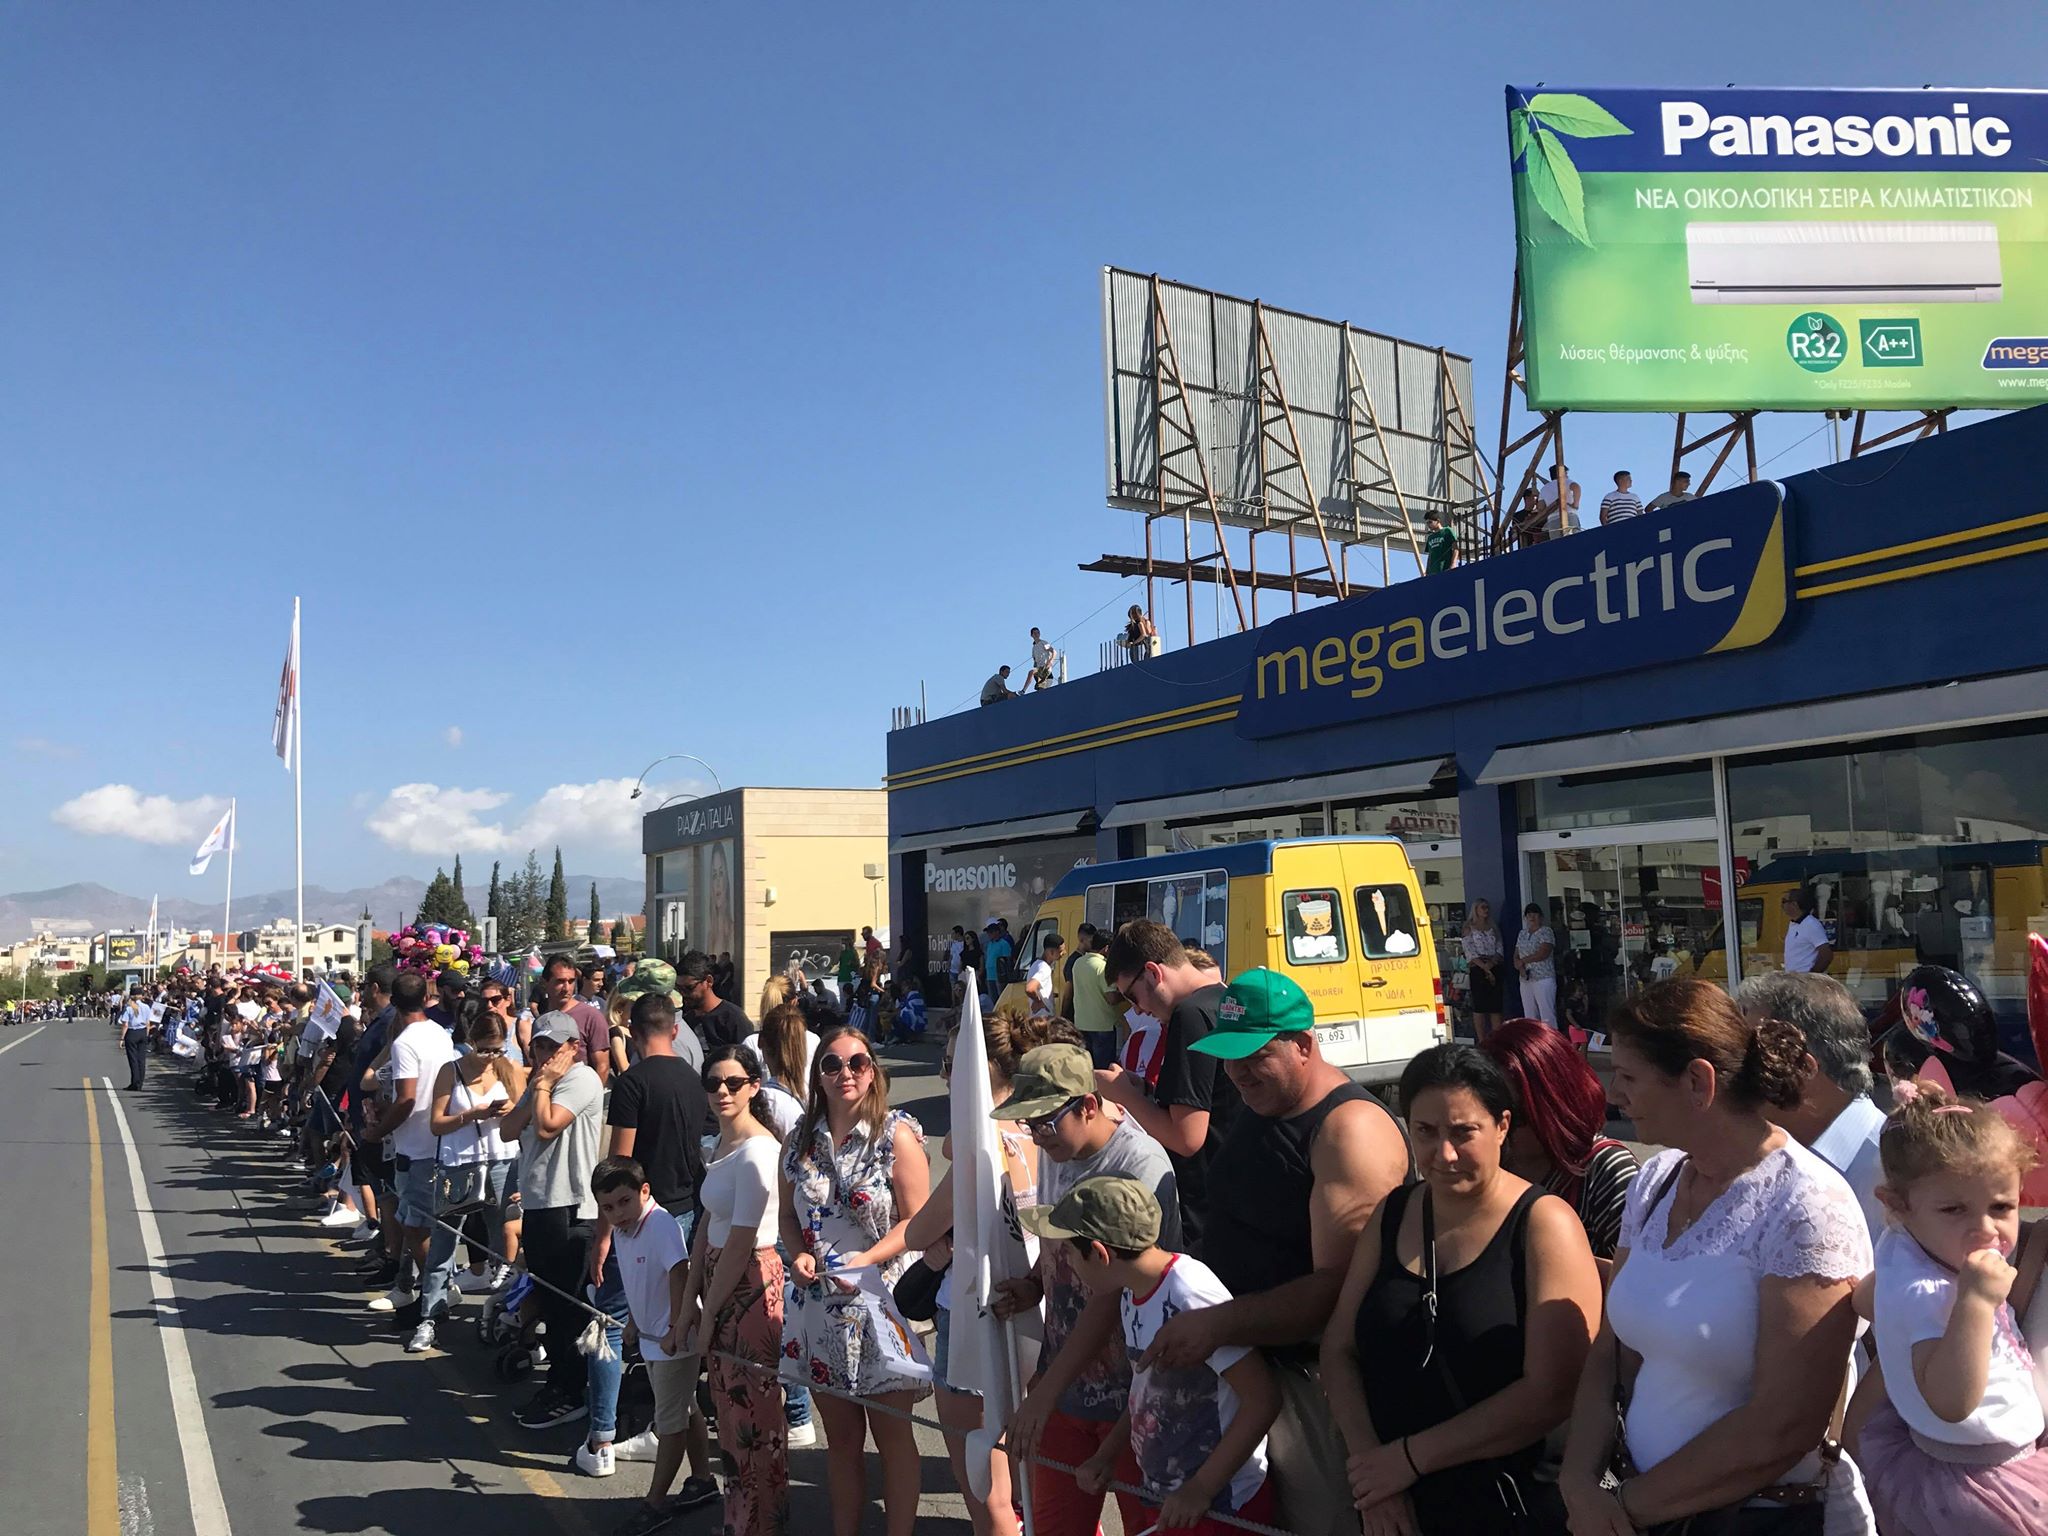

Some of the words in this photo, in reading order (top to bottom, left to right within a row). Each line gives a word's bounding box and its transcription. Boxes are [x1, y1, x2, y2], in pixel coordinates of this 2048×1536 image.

[1660, 101, 2012, 157] Panasonic
[1635, 188, 1679, 209] ΝΕΑ
[1684, 187, 1813, 209] ΟΙΚΟΛΟΓΙΚΗ
[1819, 187, 1875, 209] ΣΕΙΡΑ
[1880, 187, 2033, 209] ΚΛΙΜΑΤΙΣΤΙΚΩΝ
[1559, 344, 1606, 364] λύσεις
[1609, 343, 1687, 365] θέρμανσης
[1690, 343, 1702, 360] &
[1705, 343, 1749, 365] ψύξης
[1791, 332, 1842, 358] R32
[1878, 334, 1909, 352] A++
[1256, 528, 1736, 700] megaelectric
[677, 809, 707, 837] PIAZZA
[707, 803, 734, 830] ITALIA
[924, 855, 1017, 893] Panasonic
[1328, 1029, 1345, 1042] 693
